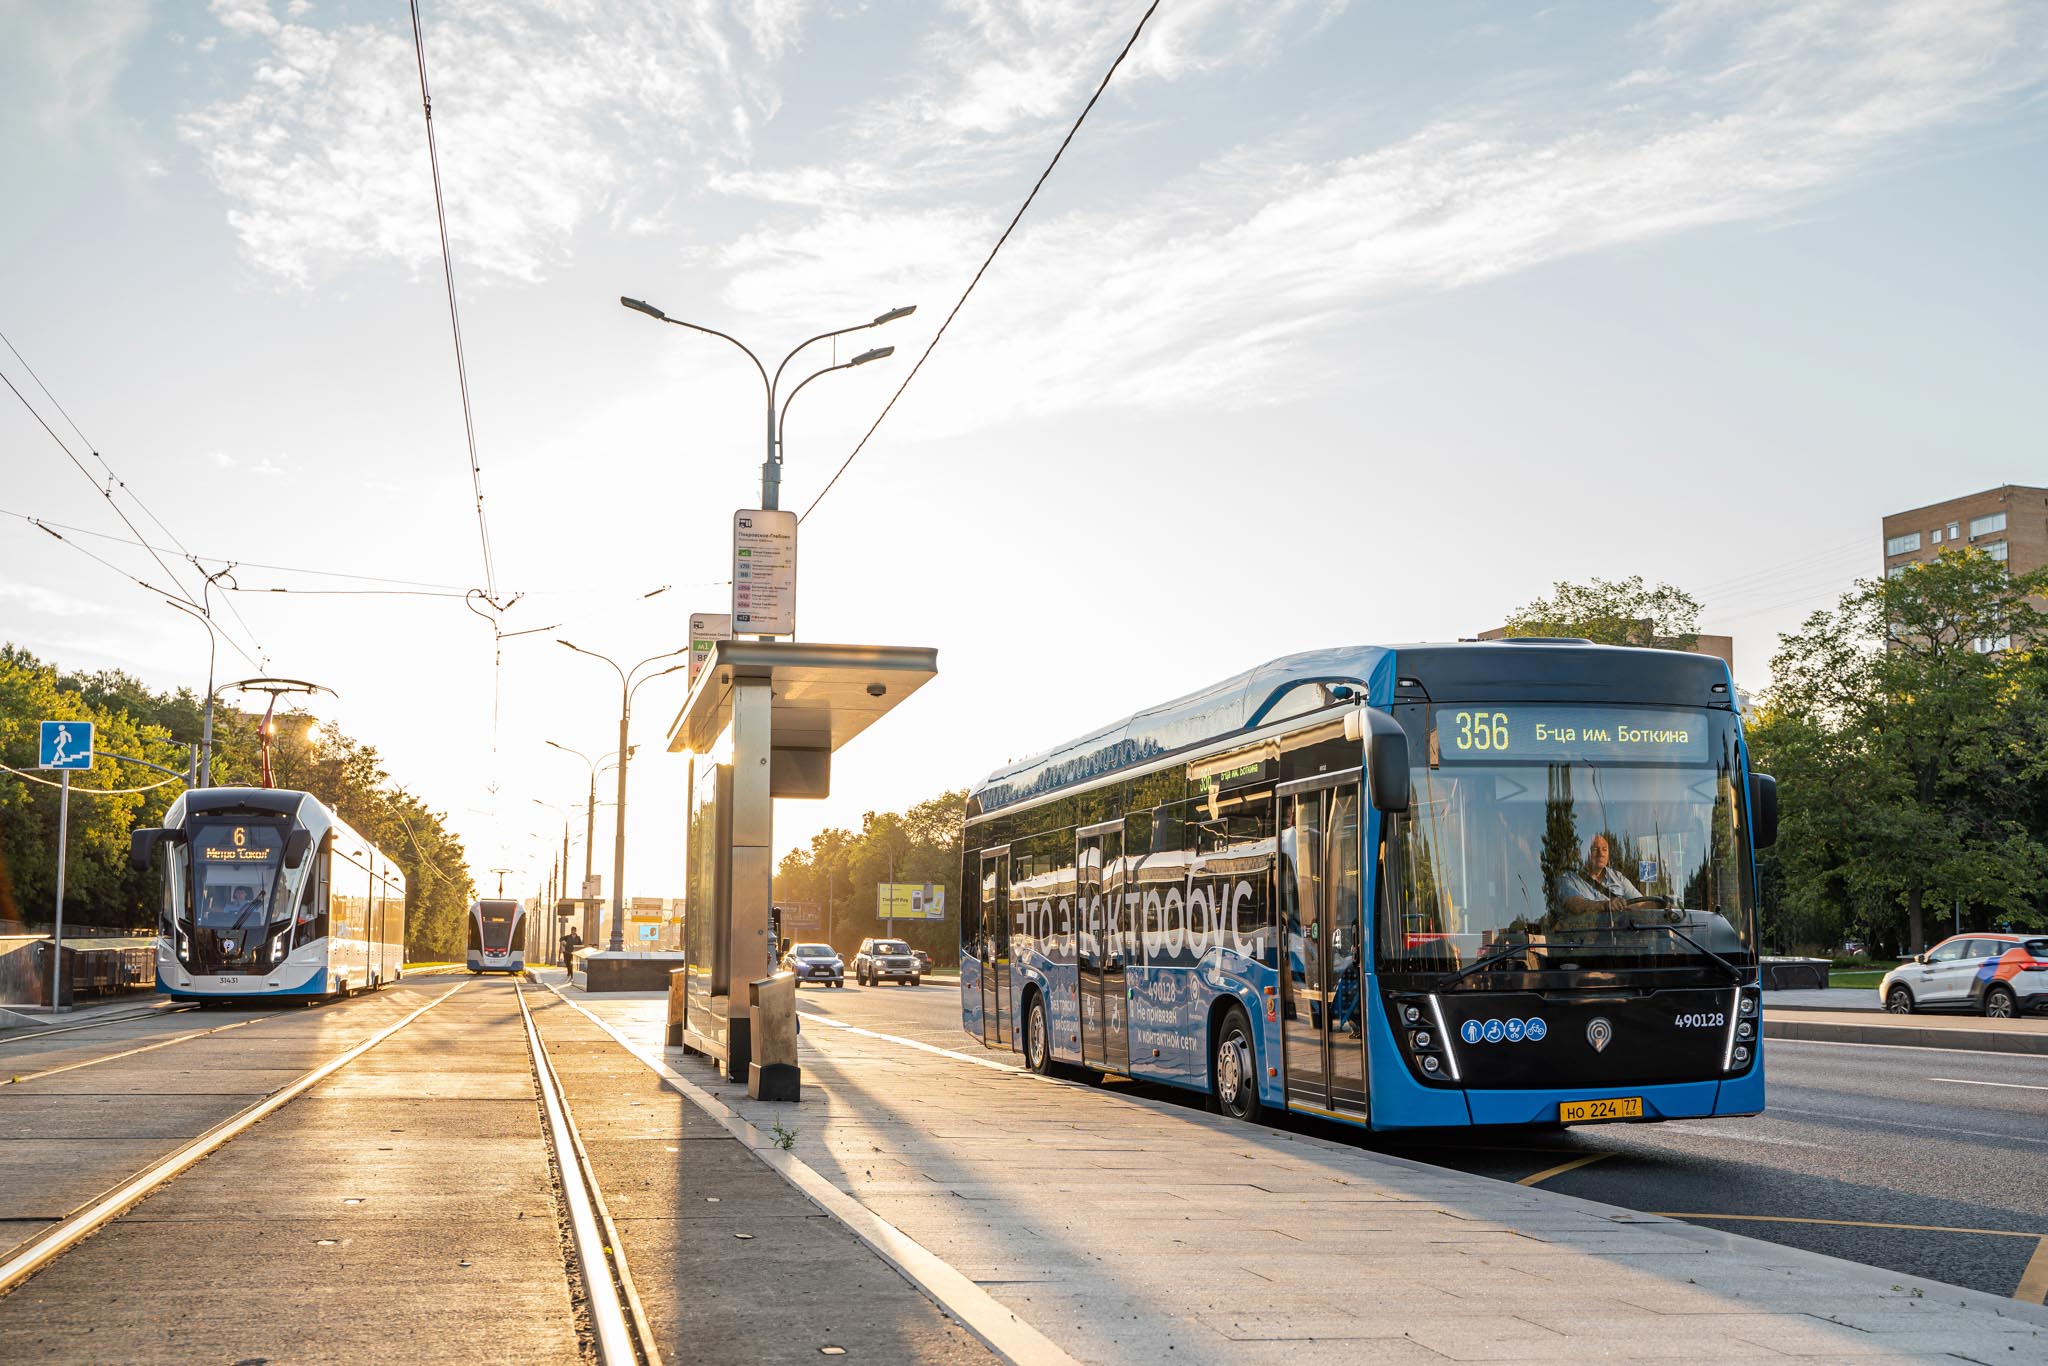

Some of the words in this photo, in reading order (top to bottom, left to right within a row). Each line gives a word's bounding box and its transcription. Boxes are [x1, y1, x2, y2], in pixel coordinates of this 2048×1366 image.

[1455, 711, 1509, 751] 356
[1535, 723, 1576, 743] Б-ца
[1583, 728, 1611, 742] им.
[1617, 725, 1689, 743] Боткина
[233, 826, 246, 847] 6
[206, 847, 236, 861] Метро
[1014, 886, 1054, 958] Это
[1058, 856, 1265, 984] электробус.
[1148, 981, 1177, 1002] 490128
[1136, 1002, 1146, 1020] Не
[1146, 1008, 1177, 1025] привязан
[1674, 1012, 1725, 1028] 490128
[1142, 1031, 1180, 1049] контактной
[1180, 1036, 1197, 1051] сети
[1590, 1101, 1616, 1118] 224
[1623, 1099, 1637, 1111] 77
